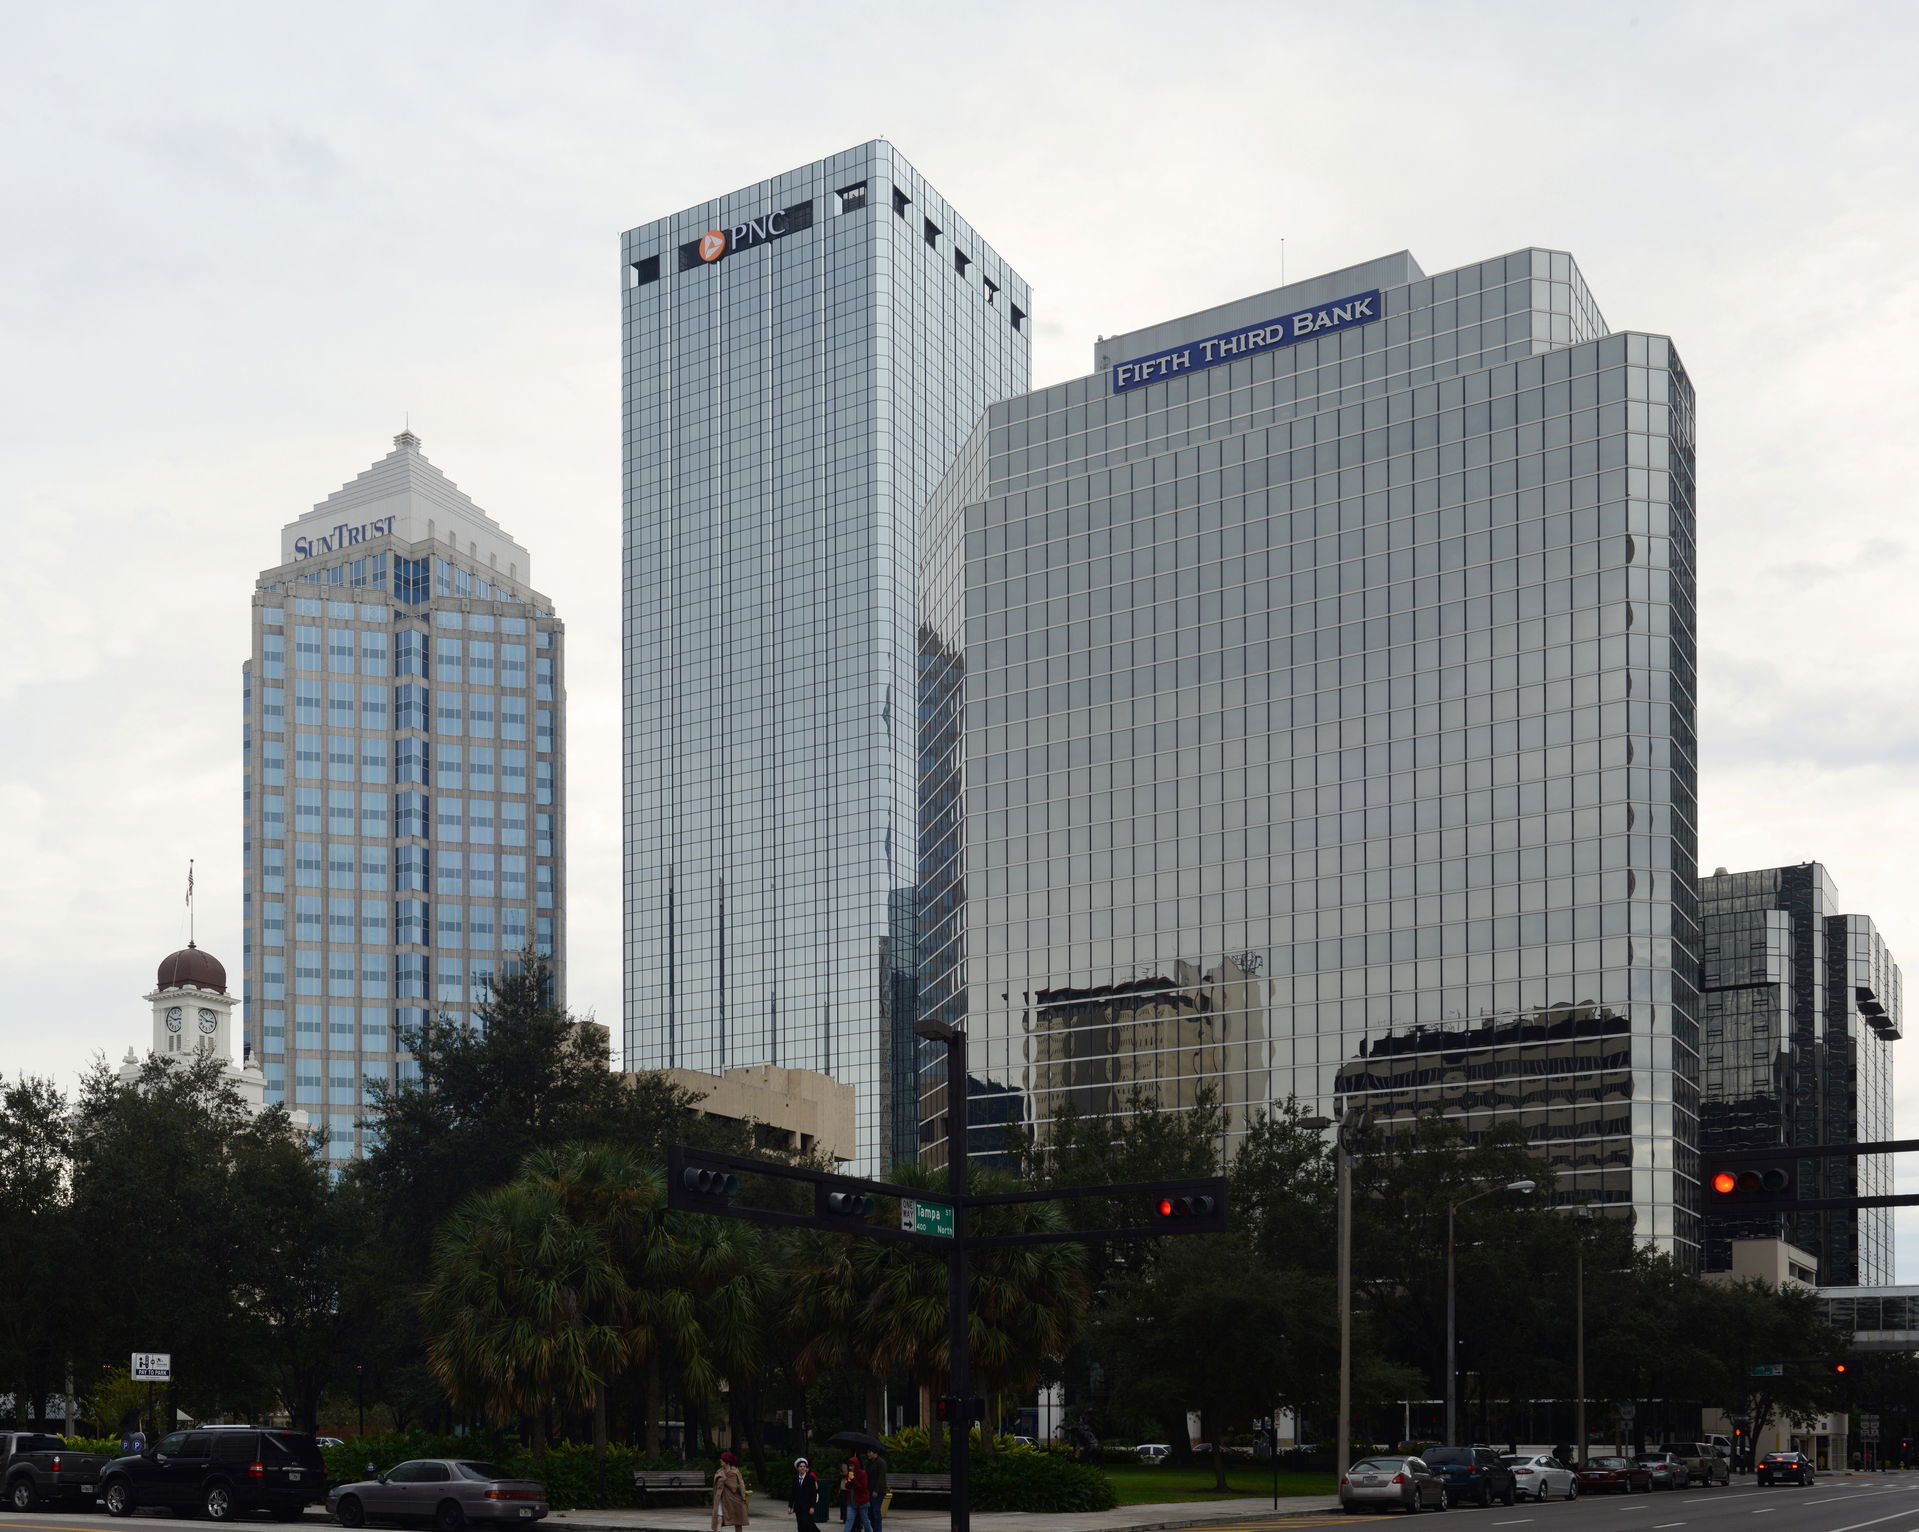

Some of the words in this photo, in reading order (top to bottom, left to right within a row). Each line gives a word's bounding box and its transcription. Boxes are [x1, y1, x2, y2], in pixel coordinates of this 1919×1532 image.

[731, 210, 786, 250] PNC
[1117, 350, 1191, 387] FIFTH
[1199, 324, 1284, 362] THIRD
[1292, 297, 1374, 337] BANK
[903, 1200, 914, 1210] ONE
[903, 1210, 914, 1219] WAY
[917, 1204, 941, 1221] Tampa
[917, 1223, 927, 1231] 400
[937, 1225, 953, 1235] North
